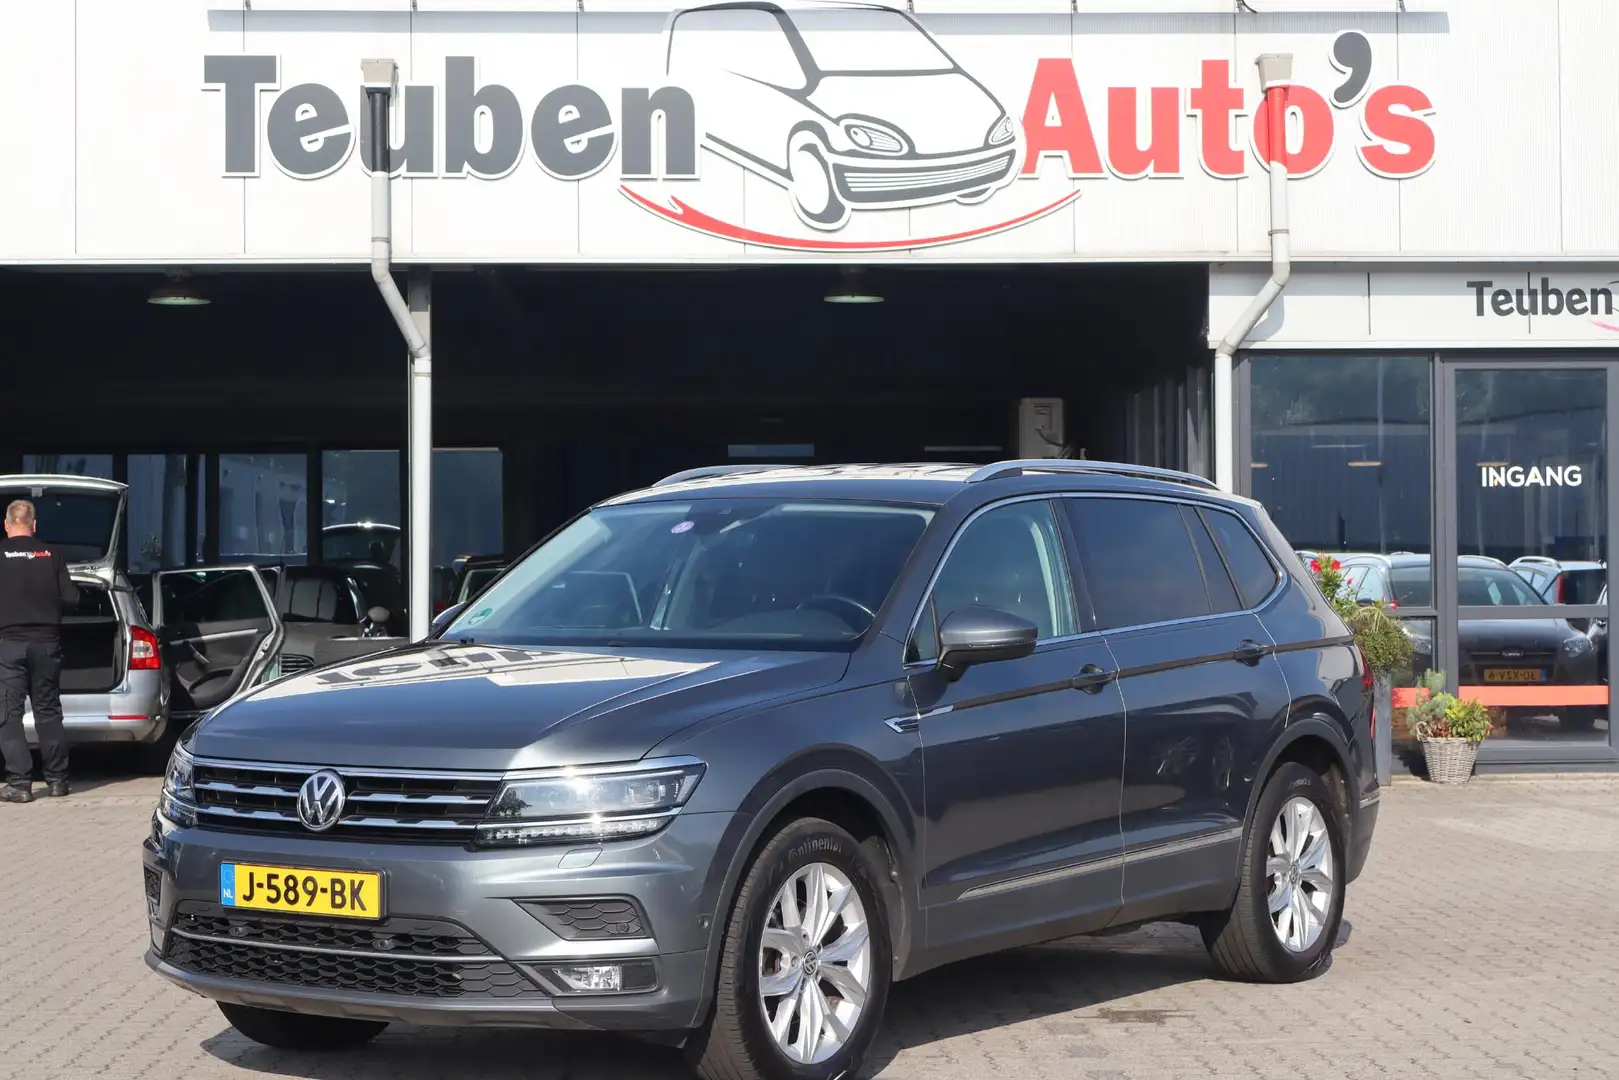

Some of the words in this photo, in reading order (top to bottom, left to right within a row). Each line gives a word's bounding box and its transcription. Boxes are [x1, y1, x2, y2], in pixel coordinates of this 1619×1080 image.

[203, 55, 696, 179] Teuben
[1020, 32, 1437, 177] Auto's
[1466, 277, 1613, 316] Teuben
[1481, 465, 1583, 487] INGANG
[223, 888, 233, 899] NL
[242, 871, 367, 912] J-589-BK
